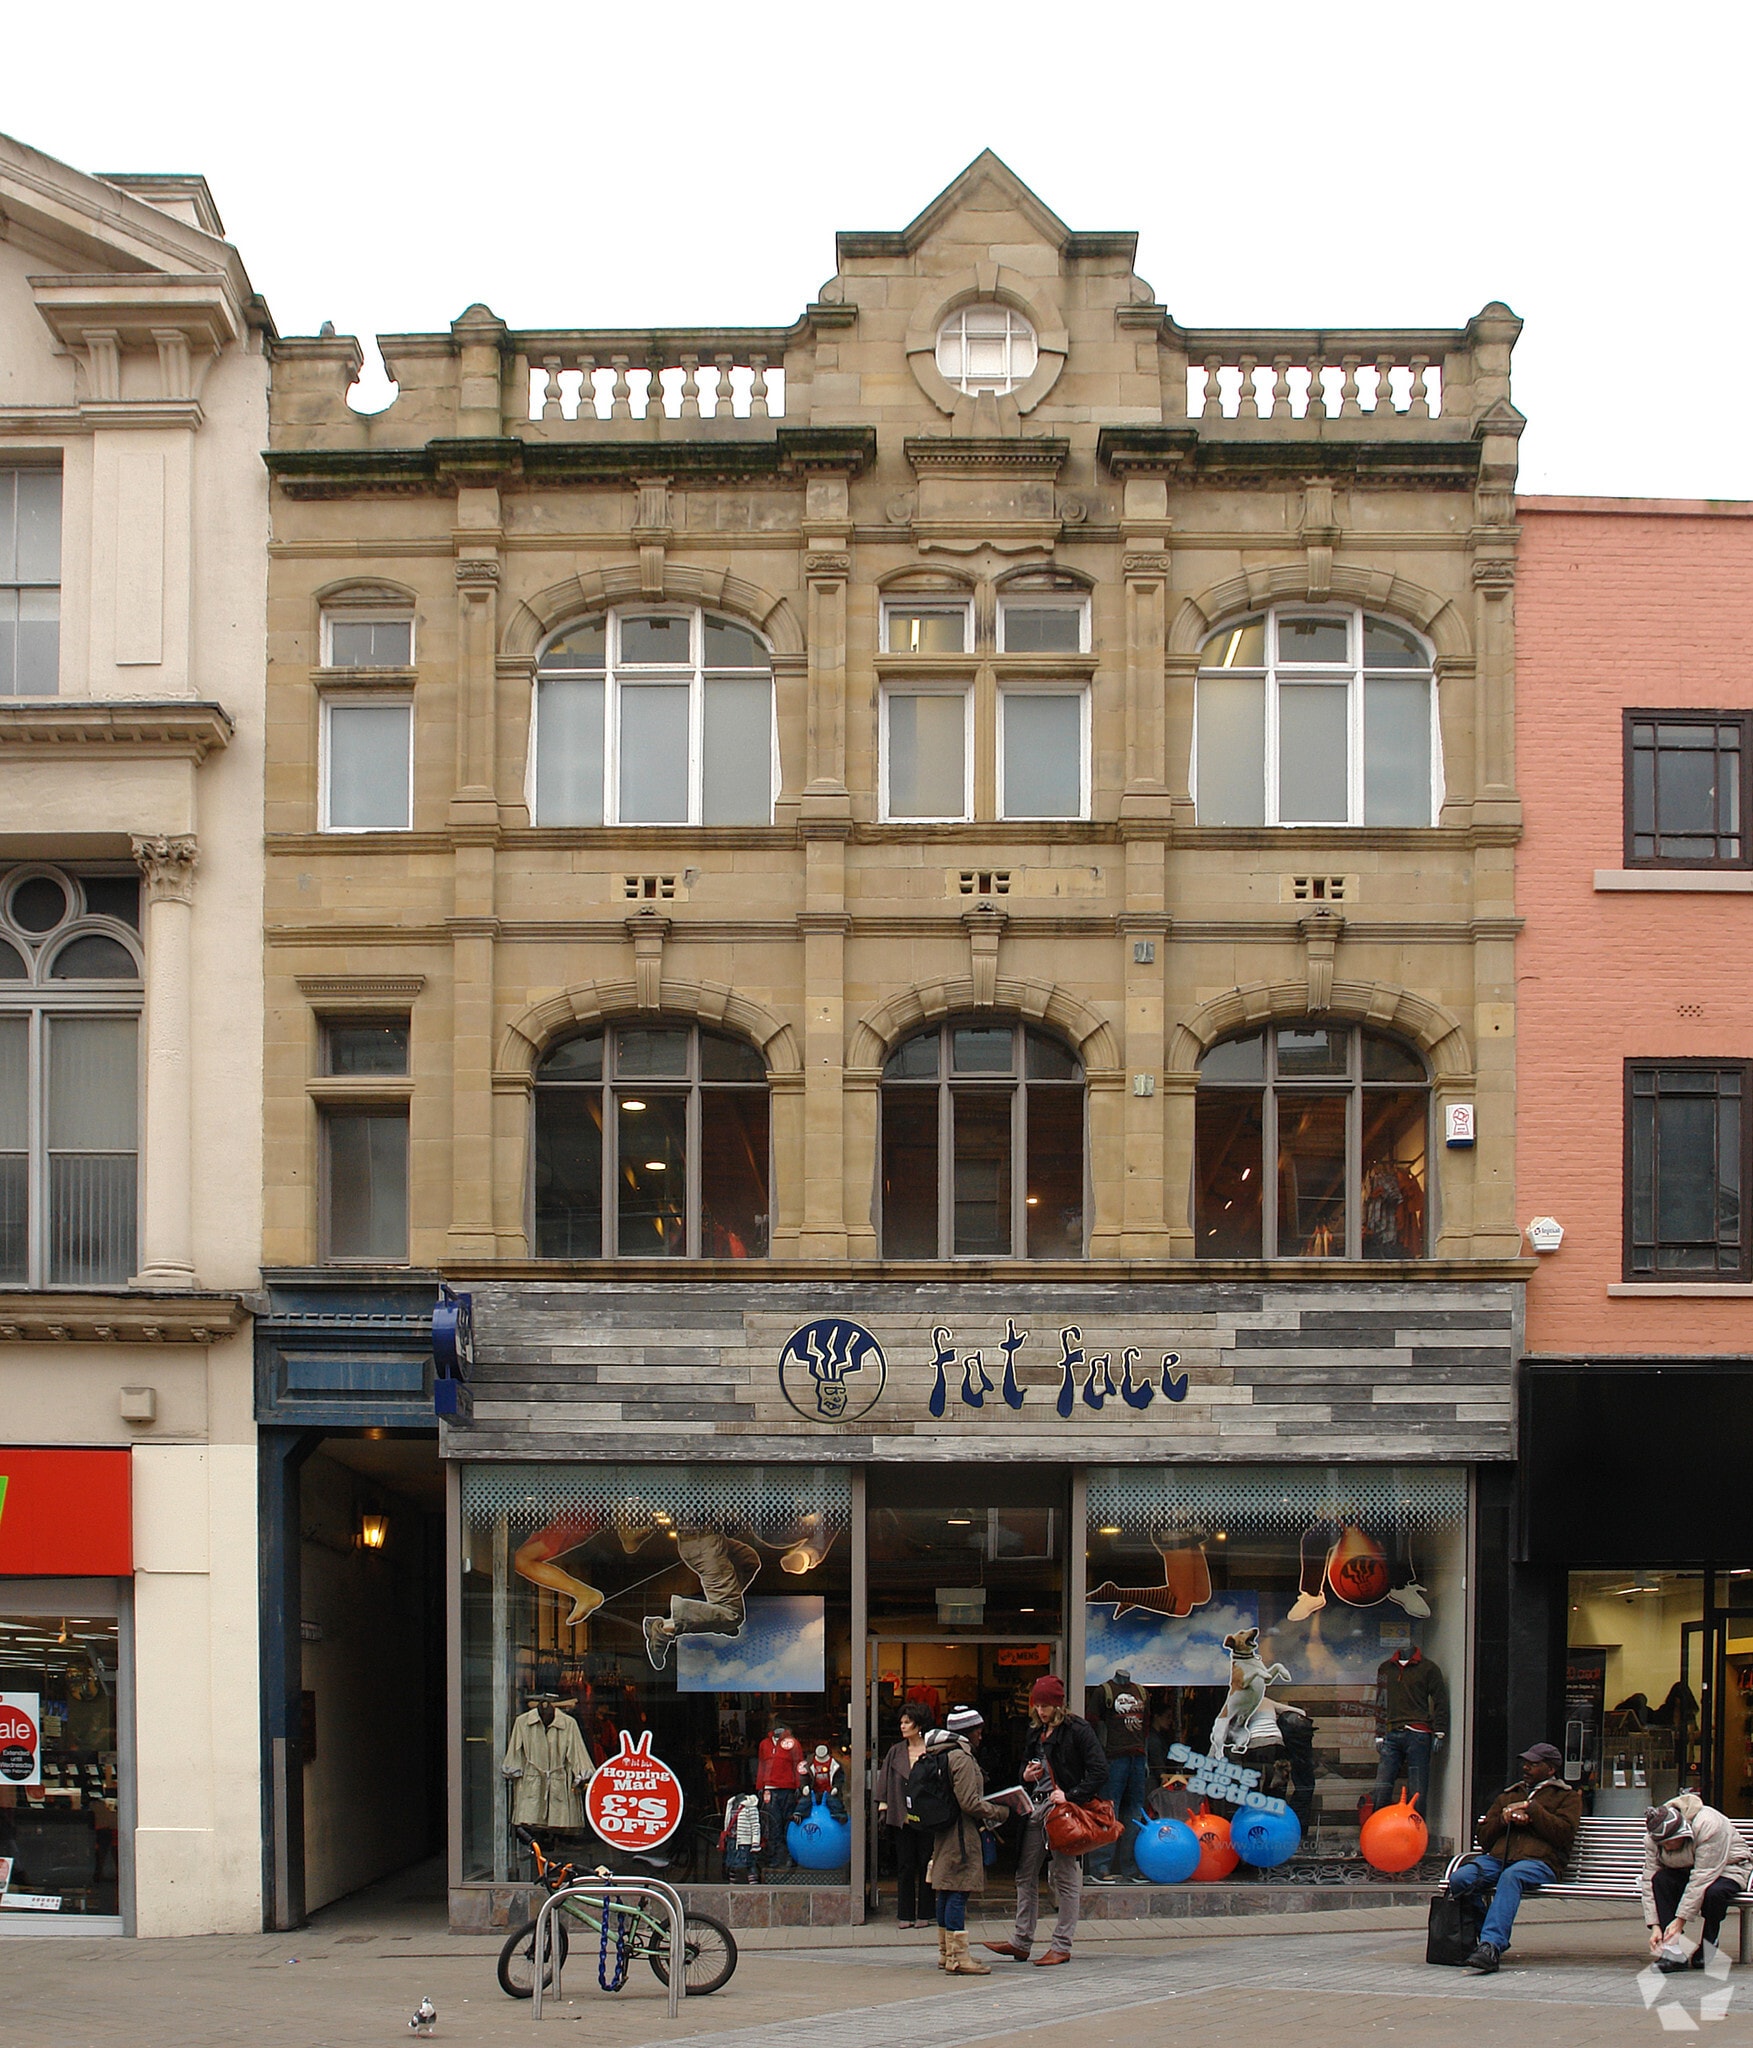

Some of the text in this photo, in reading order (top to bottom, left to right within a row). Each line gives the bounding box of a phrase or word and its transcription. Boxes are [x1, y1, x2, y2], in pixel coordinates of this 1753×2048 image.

[929, 1318, 1189, 1418] fat face
[602, 1767, 671, 1782] Hopping
[1167, 1742, 1262, 1788] Spring
[1196, 1768, 1232, 1786] into
[613, 1779, 658, 1791] Mad
[1186, 1777, 1287, 1815] action
